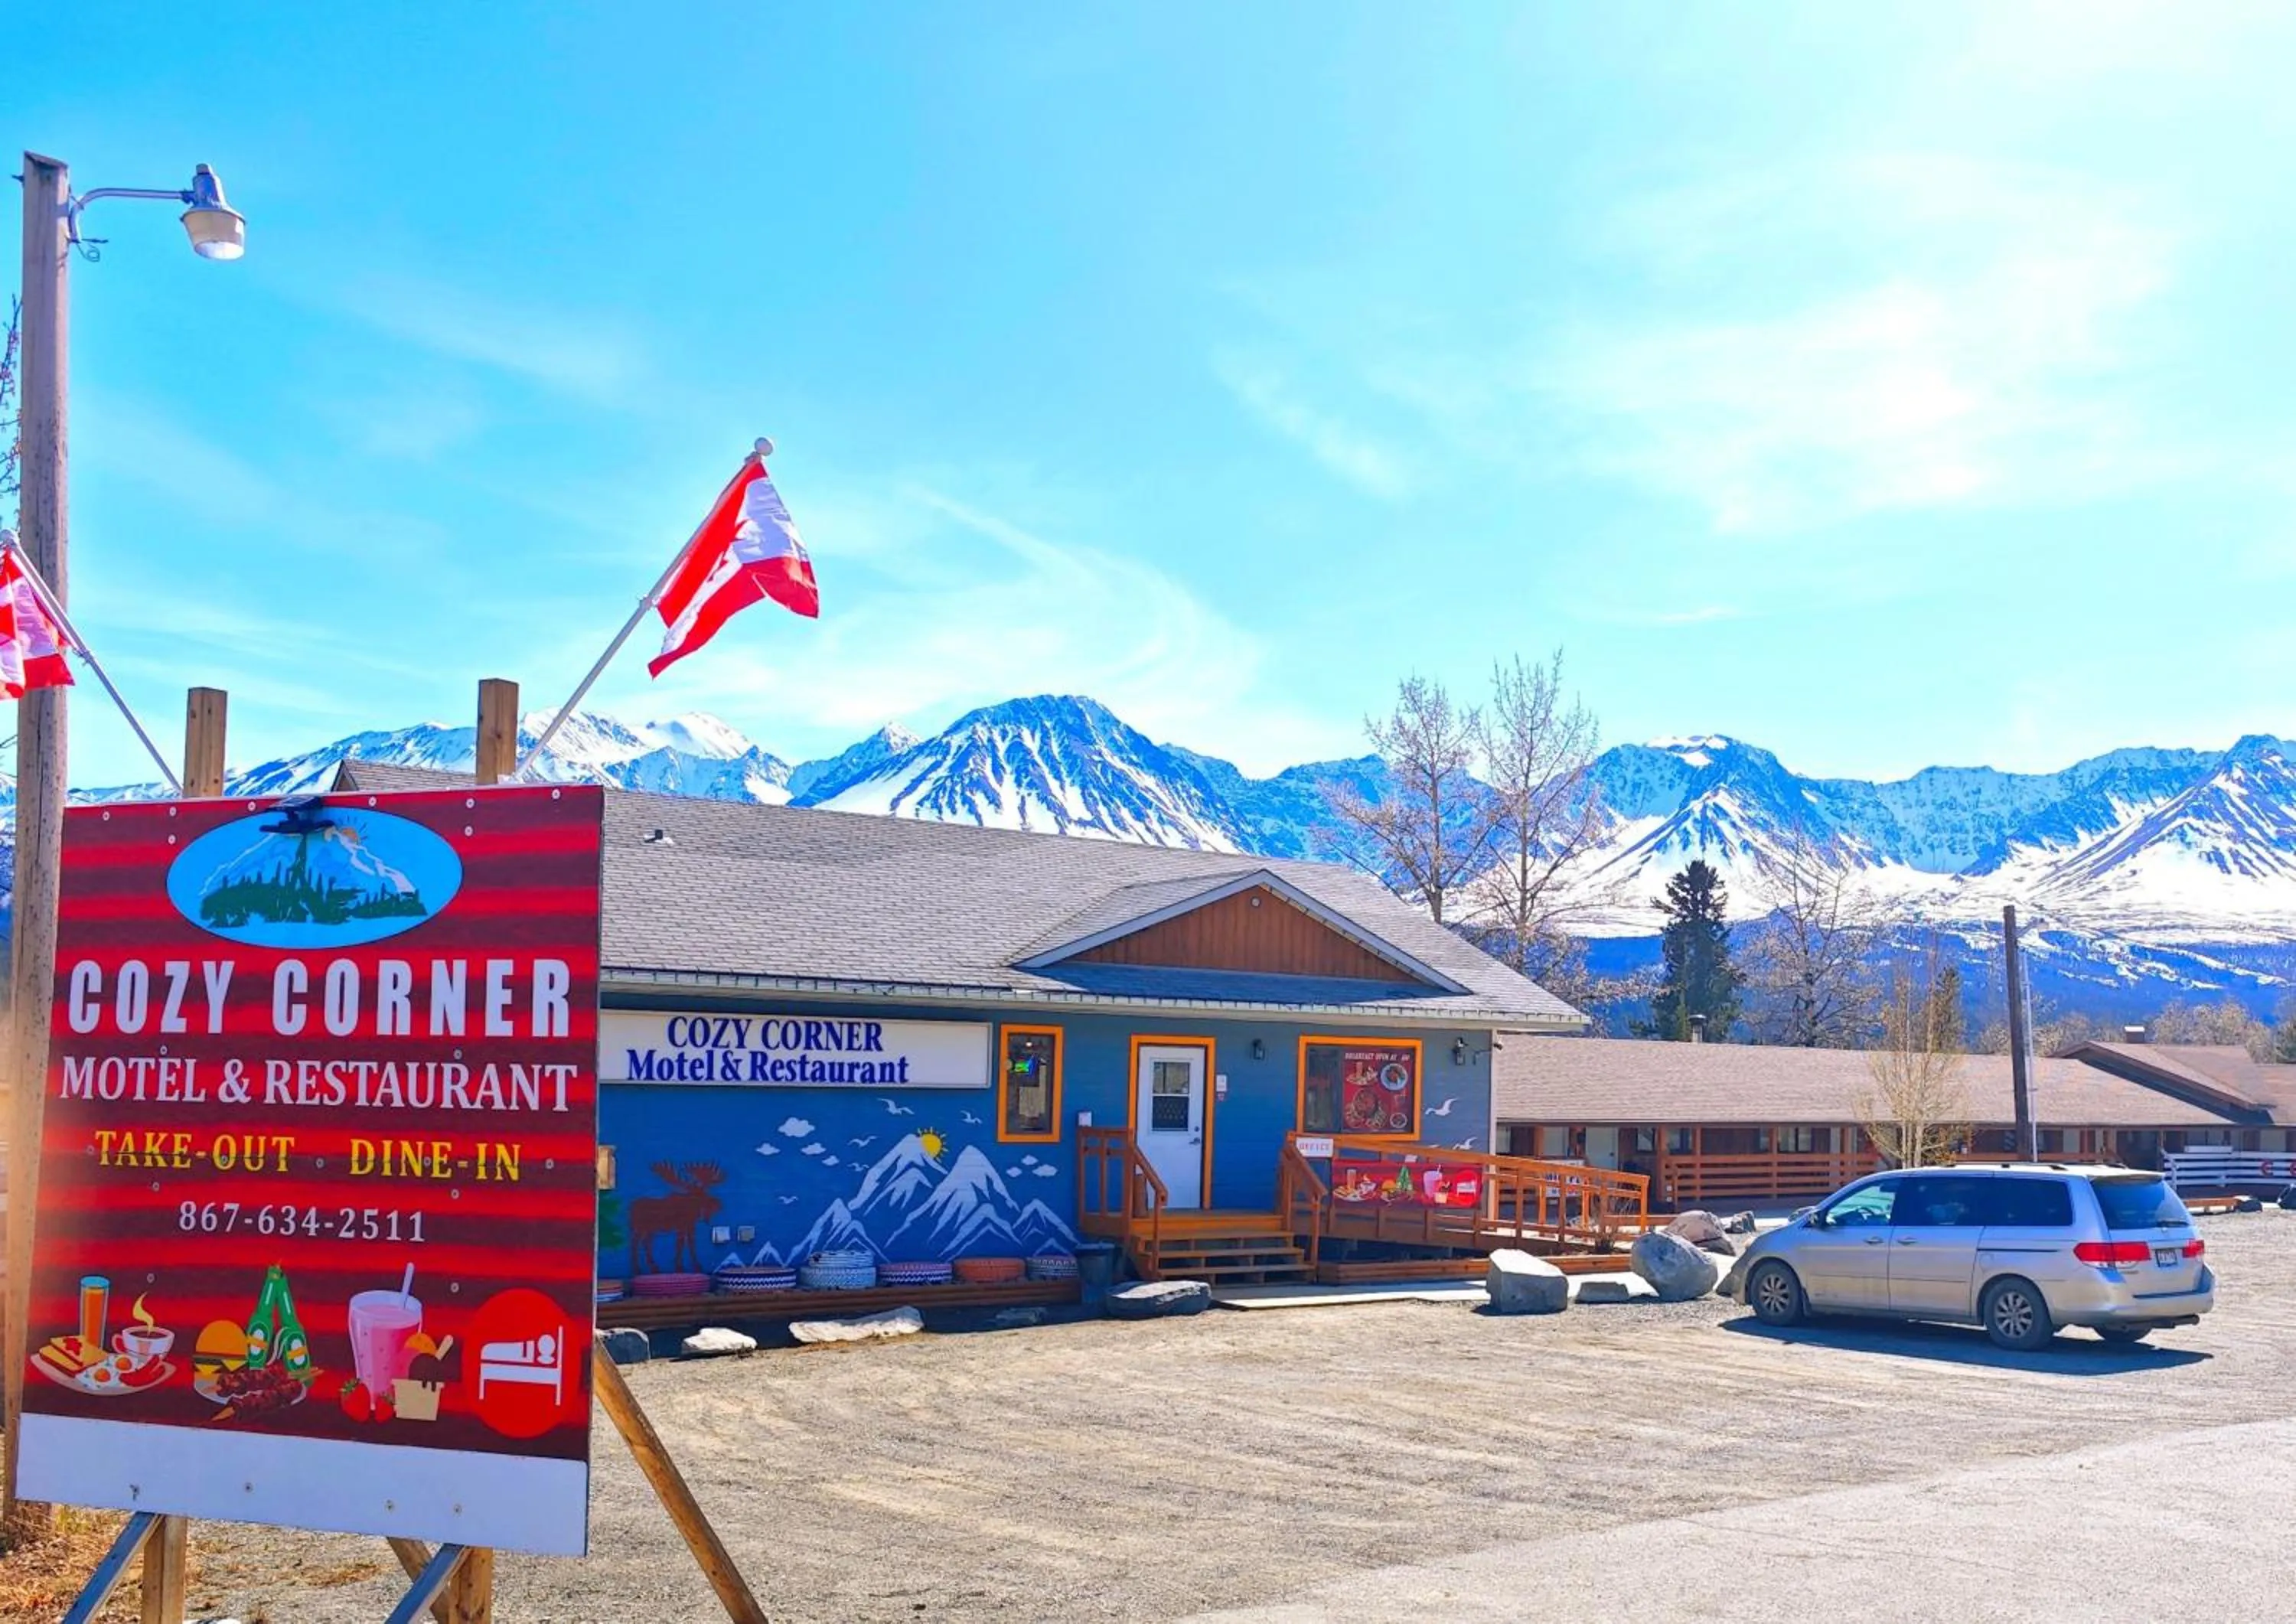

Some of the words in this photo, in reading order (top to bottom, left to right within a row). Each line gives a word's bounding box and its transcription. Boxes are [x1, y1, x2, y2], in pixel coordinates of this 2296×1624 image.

[68, 959, 236, 1034] COZY
[272, 958, 571, 1037] CORNER
[667, 1016, 752, 1049] COZY
[761, 1019, 883, 1052] CORNER
[60, 1055, 207, 1103] MOTEL
[218, 1058, 252, 1104] &
[263, 1059, 578, 1112] RESTAURANT
[627, 1049, 714, 1081] Motel
[721, 1049, 743, 1081] &
[748, 1050, 909, 1084] Restaurant
[95, 1130, 295, 1172] TAKE-OUT
[349, 1138, 521, 1181] DINE-IN
[178, 1200, 426, 1243] 867-634-2511
